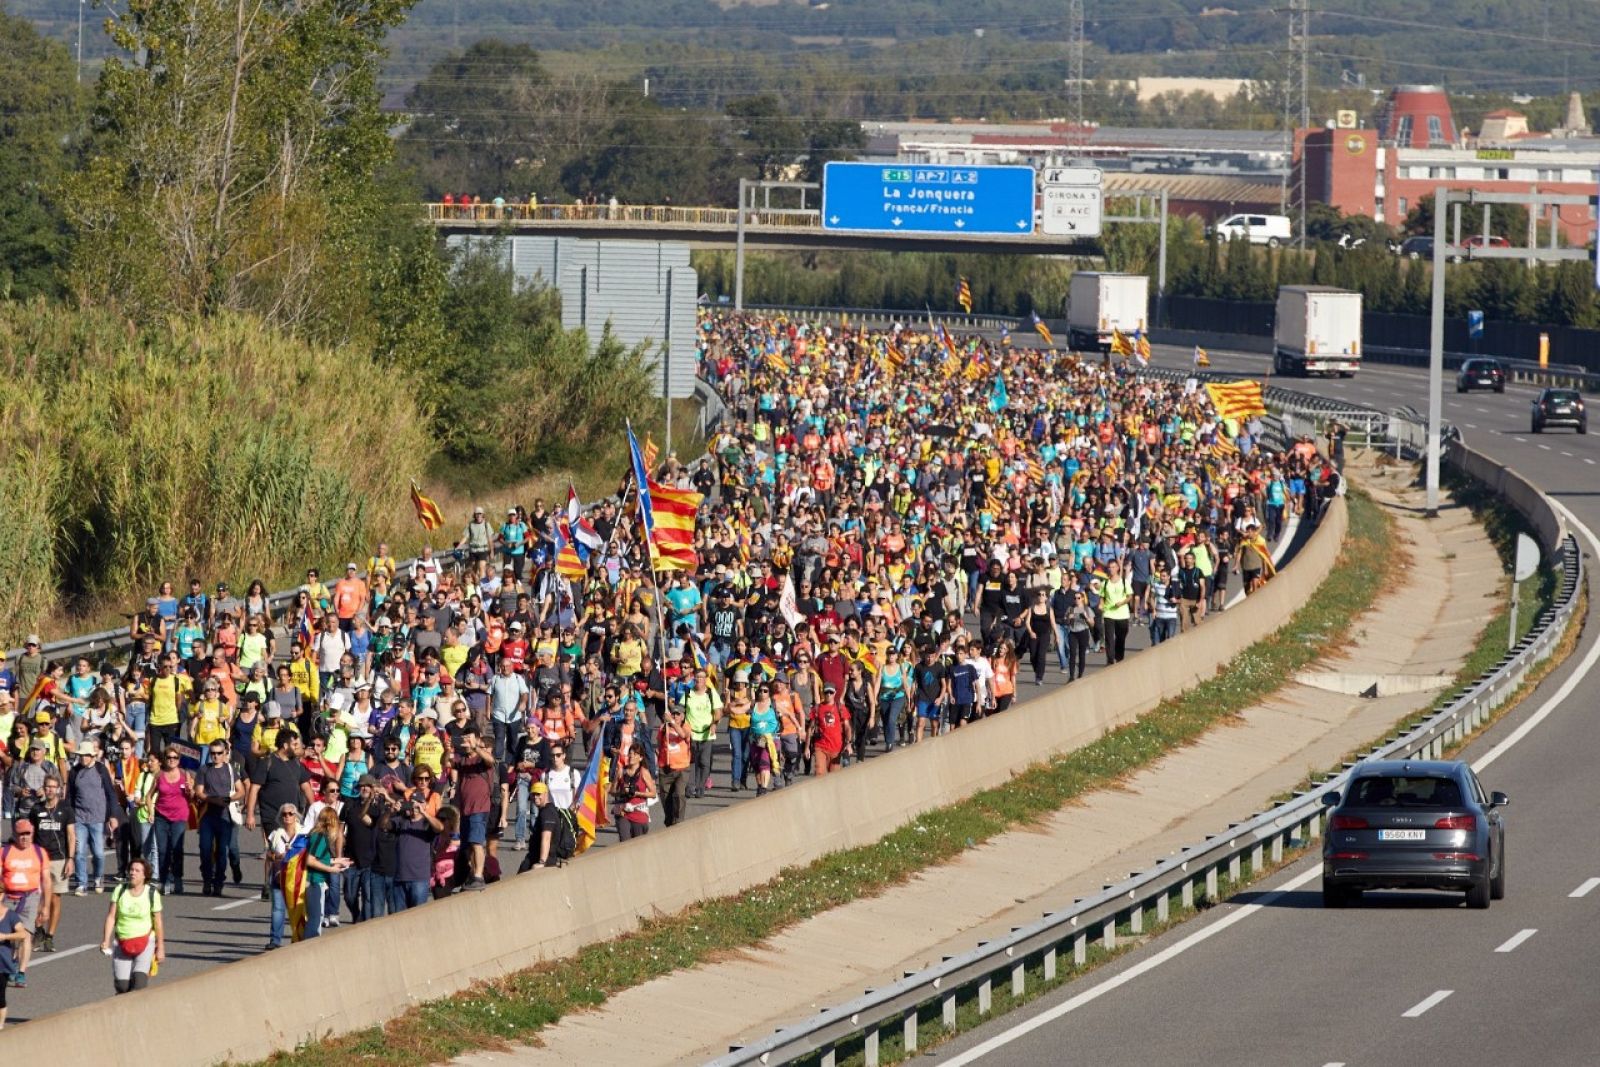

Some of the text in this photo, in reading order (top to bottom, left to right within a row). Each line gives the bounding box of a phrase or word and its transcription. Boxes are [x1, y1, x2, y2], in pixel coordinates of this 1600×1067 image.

[884, 171, 976, 182] E-15 AP-7 A-2
[883, 186, 975, 202] La Jonquera
[1048, 191, 1086, 199] GIRONA
[883, 202, 974, 214] França/Francia
[1408, 831, 1424, 839] KNY
